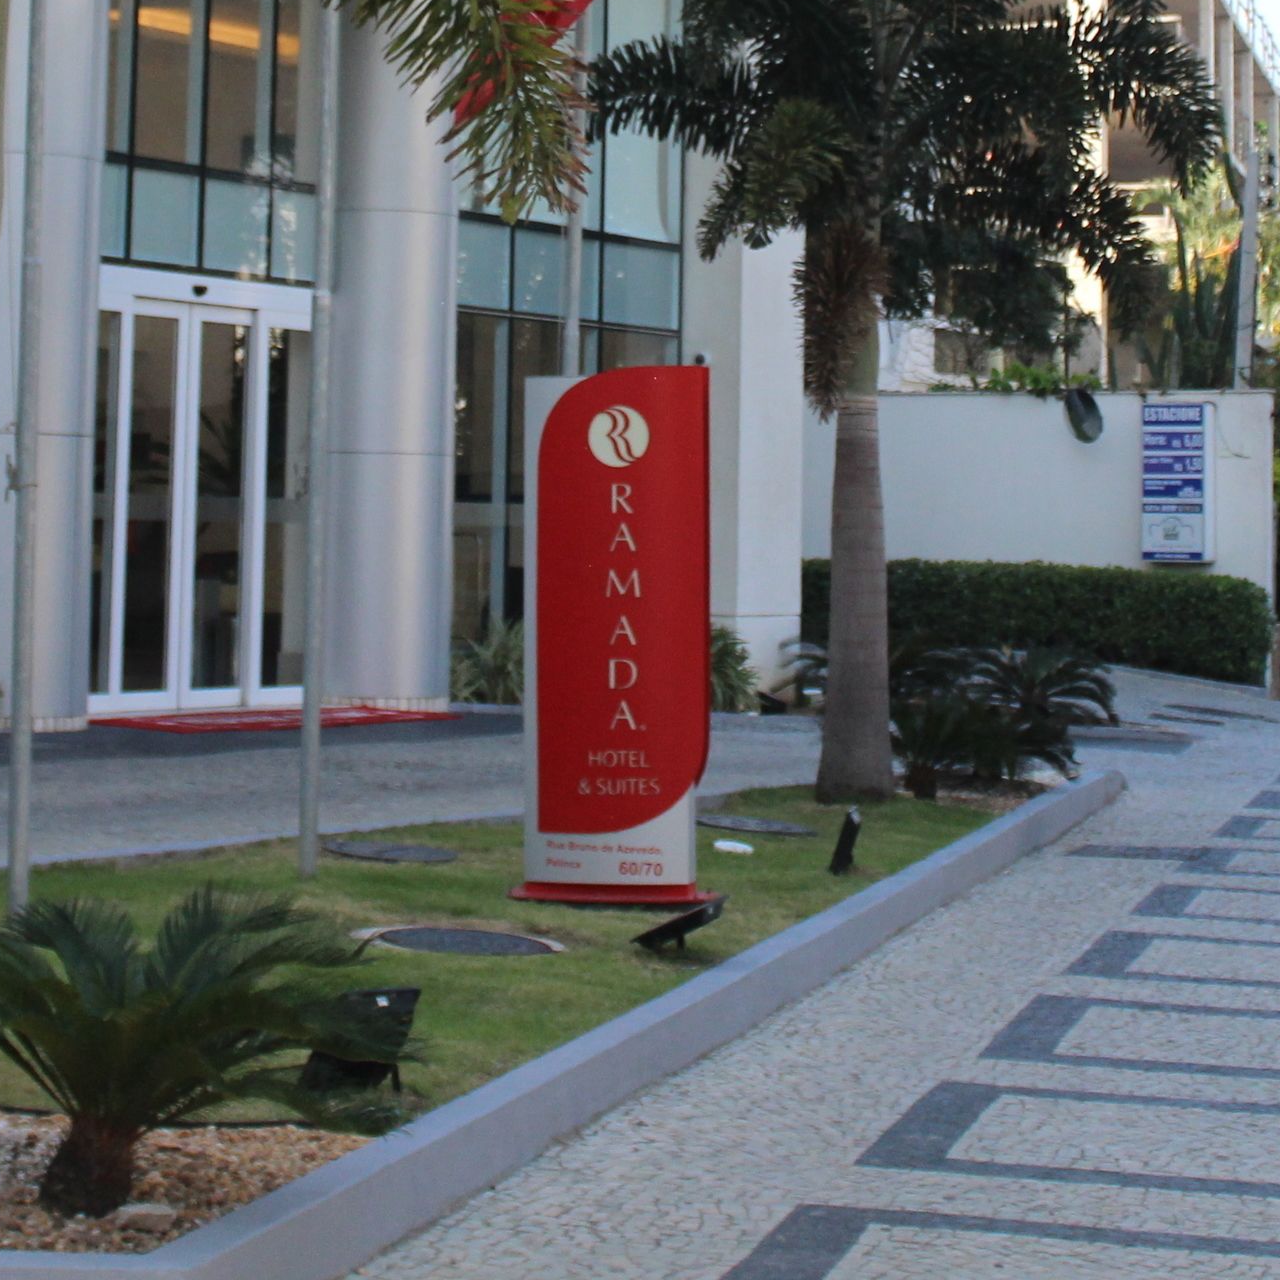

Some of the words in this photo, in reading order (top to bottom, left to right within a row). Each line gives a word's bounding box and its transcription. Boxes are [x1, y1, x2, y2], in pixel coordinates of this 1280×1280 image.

[605, 483, 642, 731] RAMADA
[588, 751, 651, 768] HOTEL
[578, 777, 591, 795] &
[596, 778, 661, 795] SUITES
[618, 861, 663, 877] 60/70
